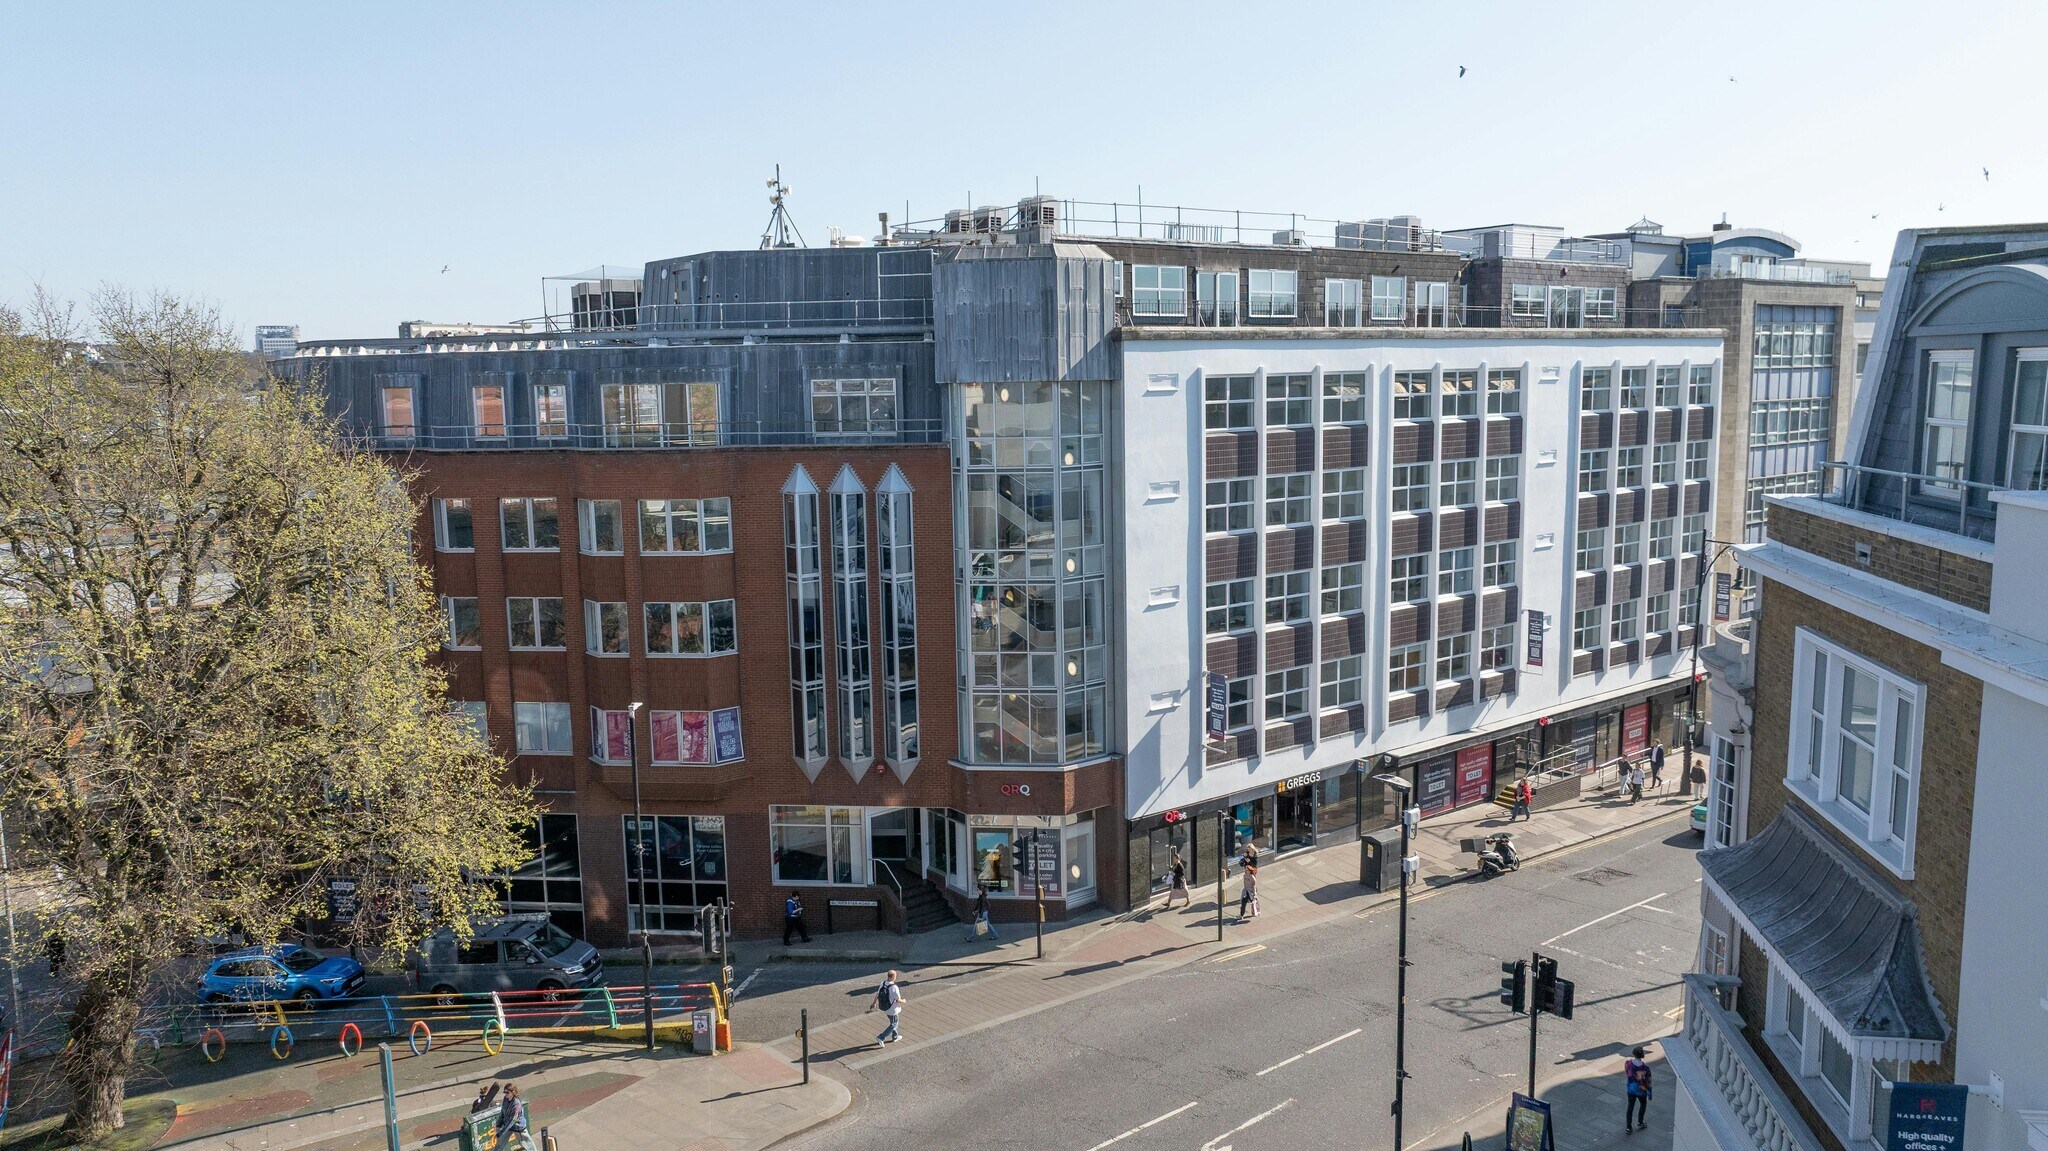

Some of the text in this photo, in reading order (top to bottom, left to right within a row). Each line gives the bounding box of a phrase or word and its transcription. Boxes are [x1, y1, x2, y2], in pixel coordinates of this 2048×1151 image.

[1287, 772, 1320, 789] GREGGS
[1001, 784, 1030, 796] QRQ
[1898, 1131, 1954, 1143] High quality
[1905, 1142, 1937, 1150] offices
